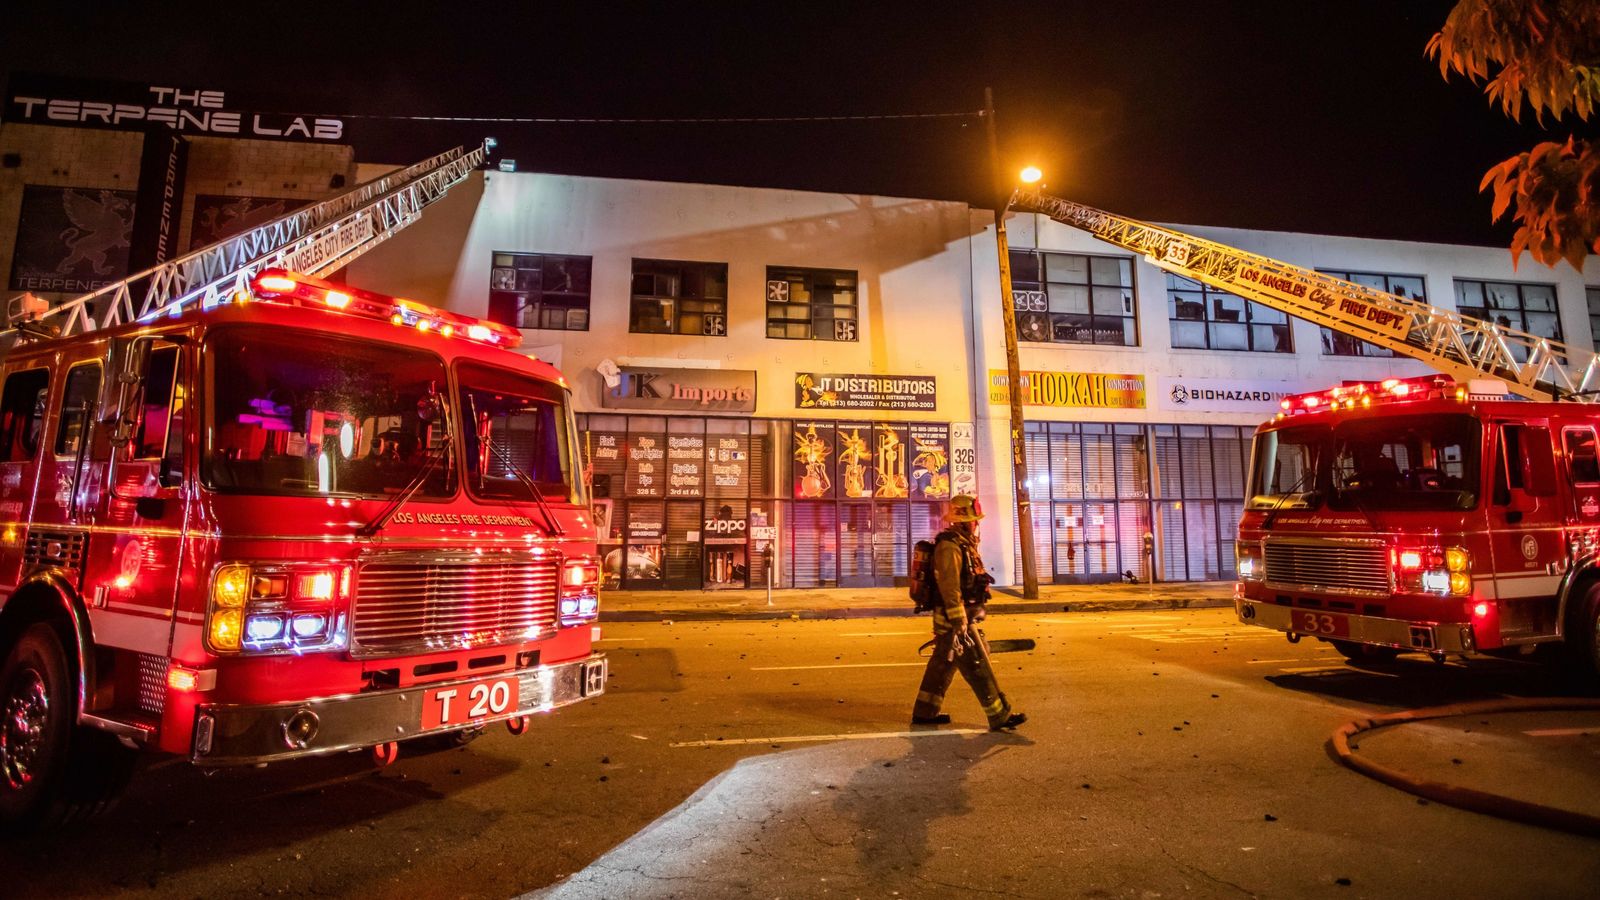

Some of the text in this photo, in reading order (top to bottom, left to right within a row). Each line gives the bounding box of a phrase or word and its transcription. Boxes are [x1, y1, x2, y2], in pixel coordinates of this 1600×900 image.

[150, 86, 225, 108] THE
[14, 96, 343, 139] TERPENE LAB
[291, 243, 324, 273] ANGELES
[324, 234, 339, 257] CITY
[340, 227, 354, 248] FIRE
[1170, 244, 1188, 261] 33
[1240, 267, 1404, 331] LOS ANGELES City FIRE DEPT.
[611, 372, 751, 404] JK Imports
[835, 378, 935, 395] DISTRIBUTORS
[1029, 372, 1108, 406] HOOKAH
[954, 448, 975, 465] 326
[392, 512, 534, 527] LOS ANGELES FIRE DEPARTMENT
[705, 517, 746, 534] zippo
[1303, 613, 1336, 634] 33
[436, 681, 510, 723] T 20
